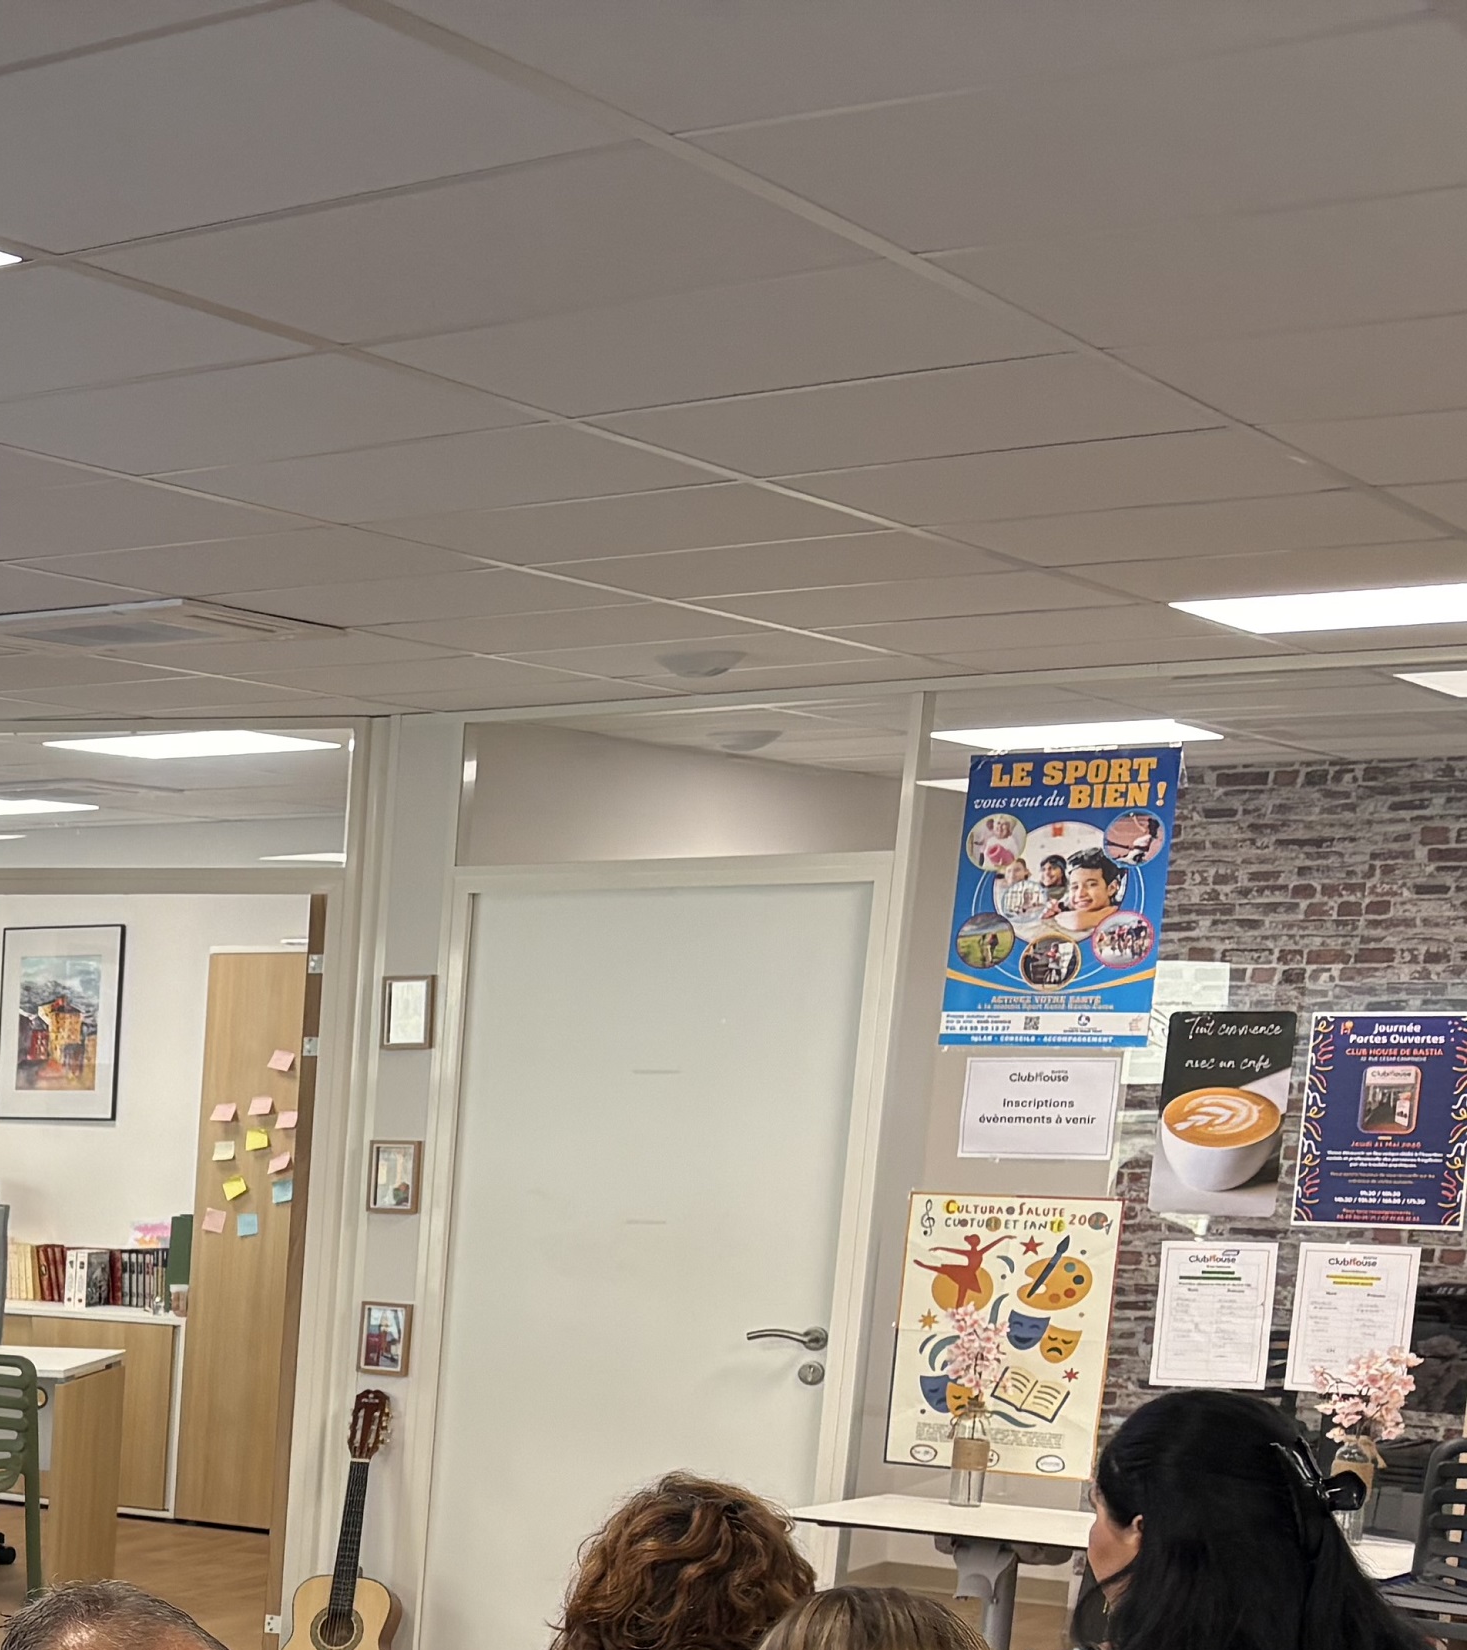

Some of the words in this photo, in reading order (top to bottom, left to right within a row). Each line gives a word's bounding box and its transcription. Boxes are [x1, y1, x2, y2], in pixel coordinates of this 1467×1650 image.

[990, 762, 1034, 788] LE
[1042, 757, 1158, 786] SPORT
[973, 795, 1007, 810] vous
[1009, 793, 1042, 808] veut
[1044, 789, 1066, 807] du
[1068, 782, 1151, 809] BIEN
[1155, 781, 1167, 808] !
[1373, 1022, 1422, 1035] Journée
[1349, 1034, 1388, 1044] Portes
[1390, 1034, 1446, 1044] Ouvertes
[1346, 1048, 1367, 1056] CLUB
[1369, 1048, 1398, 1056] HOUSE
[1400, 1048, 1411, 1056] DE
[1413, 1048, 1444, 1056] BASTIA
[1003, 1098, 1075, 1110] Inscriptions
[1055, 1114, 1063, 1124] à
[1066, 1114, 1097, 1125] venir
[1004, 1219, 1019, 1230] ET
